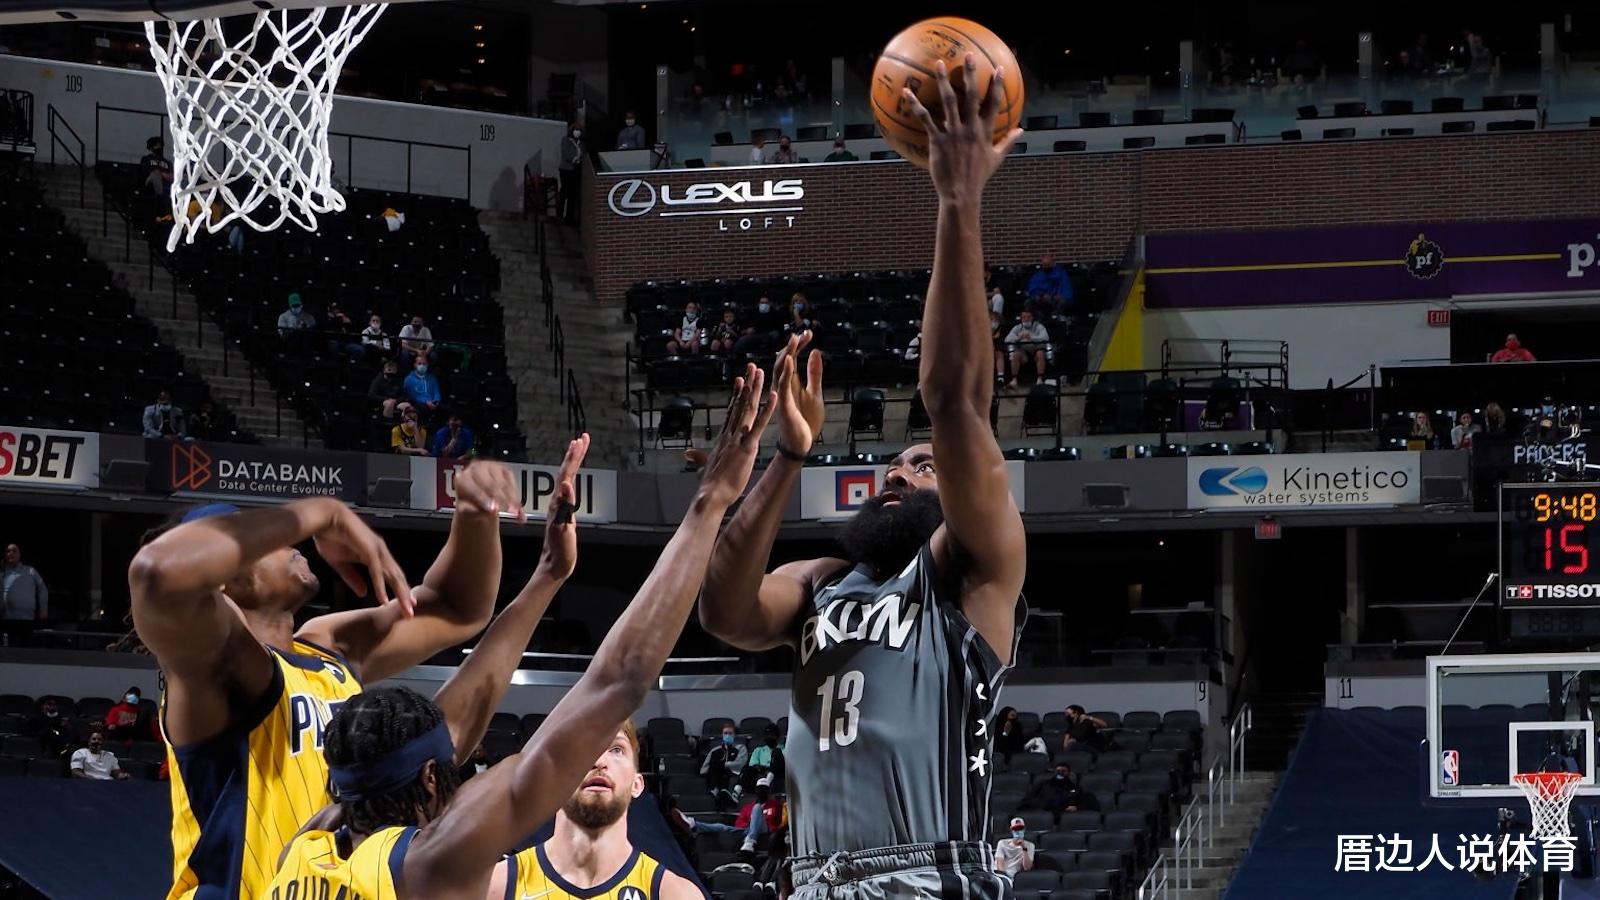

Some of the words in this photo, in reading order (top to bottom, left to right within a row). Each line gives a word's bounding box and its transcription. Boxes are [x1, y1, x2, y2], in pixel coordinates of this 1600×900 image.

[65, 74, 83, 93] 109
[480, 124, 496, 141] 109
[660, 179, 805, 205] LEXUS
[719, 216, 795, 231] LOFT
[1415, 252, 1433, 269] pf
[1430, 311, 1448, 323] EXIT
[218, 460, 343, 485] DATABANK
[1283, 466, 1408, 491] Kinetico
[219, 479, 246, 491] Data
[250, 481, 287, 493] Center
[1244, 493, 1291, 505] water
[1300, 491, 1369, 507] systems
[1534, 493, 1597, 522] 9:48
[1545, 524, 1589, 574] 15
[1198, 680, 1206, 701] 9
[1340, 678, 1354, 699] 11
[816, 670, 865, 752] 13
